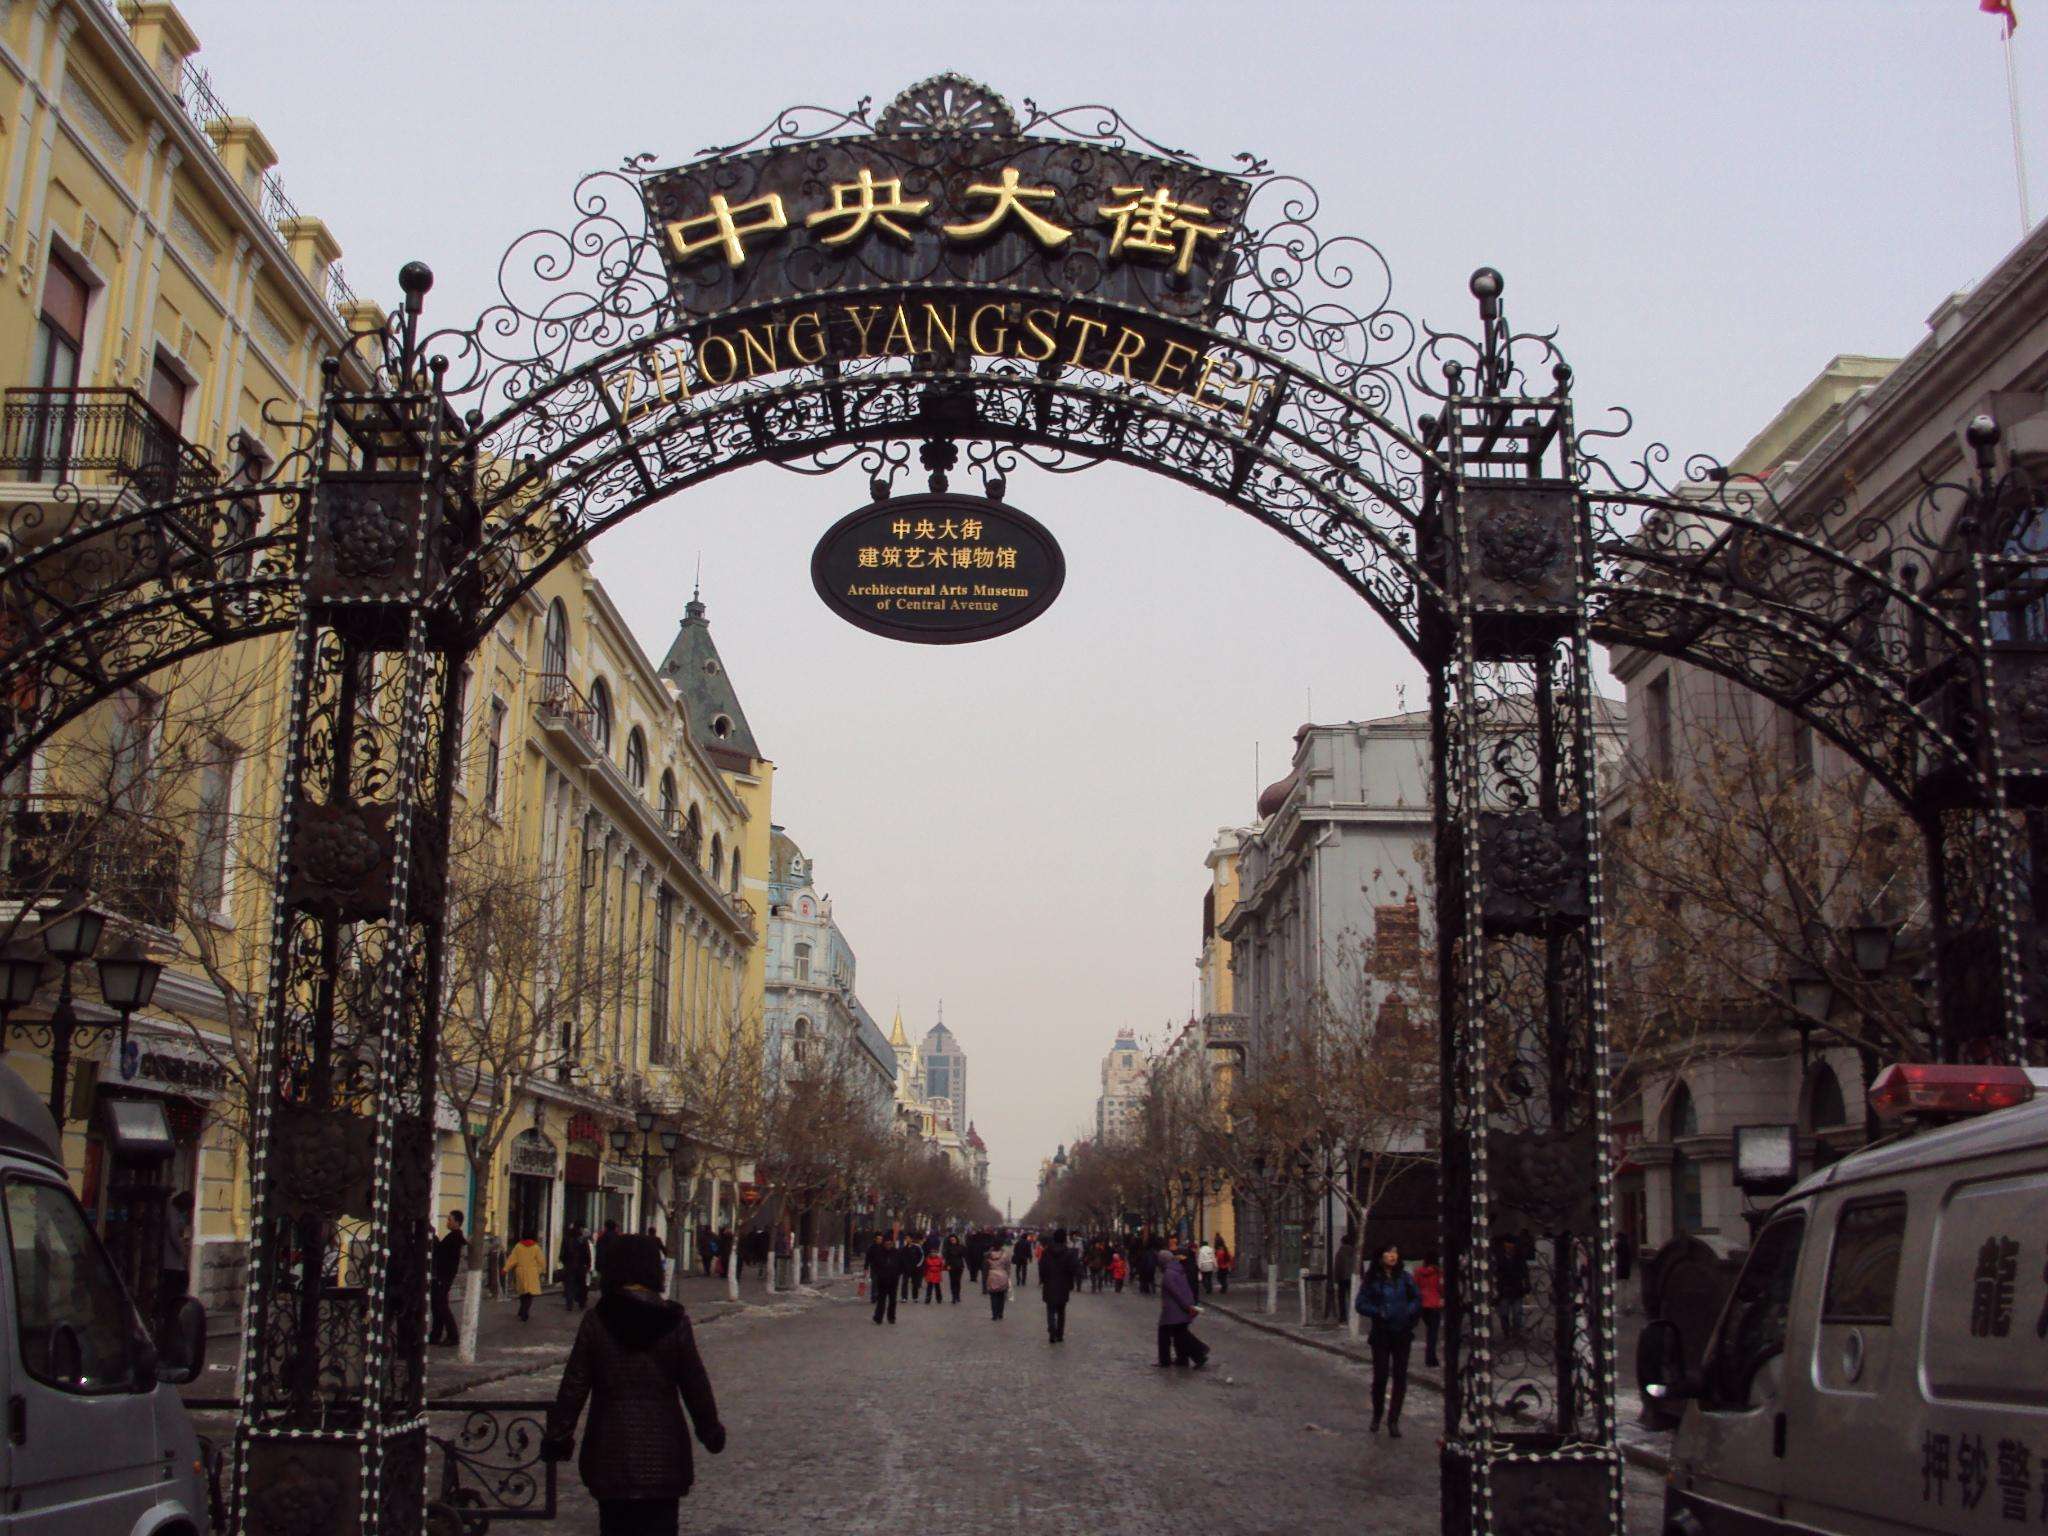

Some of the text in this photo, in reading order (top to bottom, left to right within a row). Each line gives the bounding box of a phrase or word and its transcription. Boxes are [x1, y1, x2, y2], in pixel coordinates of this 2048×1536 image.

[666, 168, 1227, 277] 中央大街
[603, 312, 828, 425] ZHONG
[892, 518, 983, 539] 中央大街
[857, 546, 1018, 568] 建筑艺术博物馆
[847, 584, 1028, 598] Architectural Arts Museum
[876, 598, 999, 611] of Central Avenue
[1921, 1429, 2048, 1523] 押钞警
